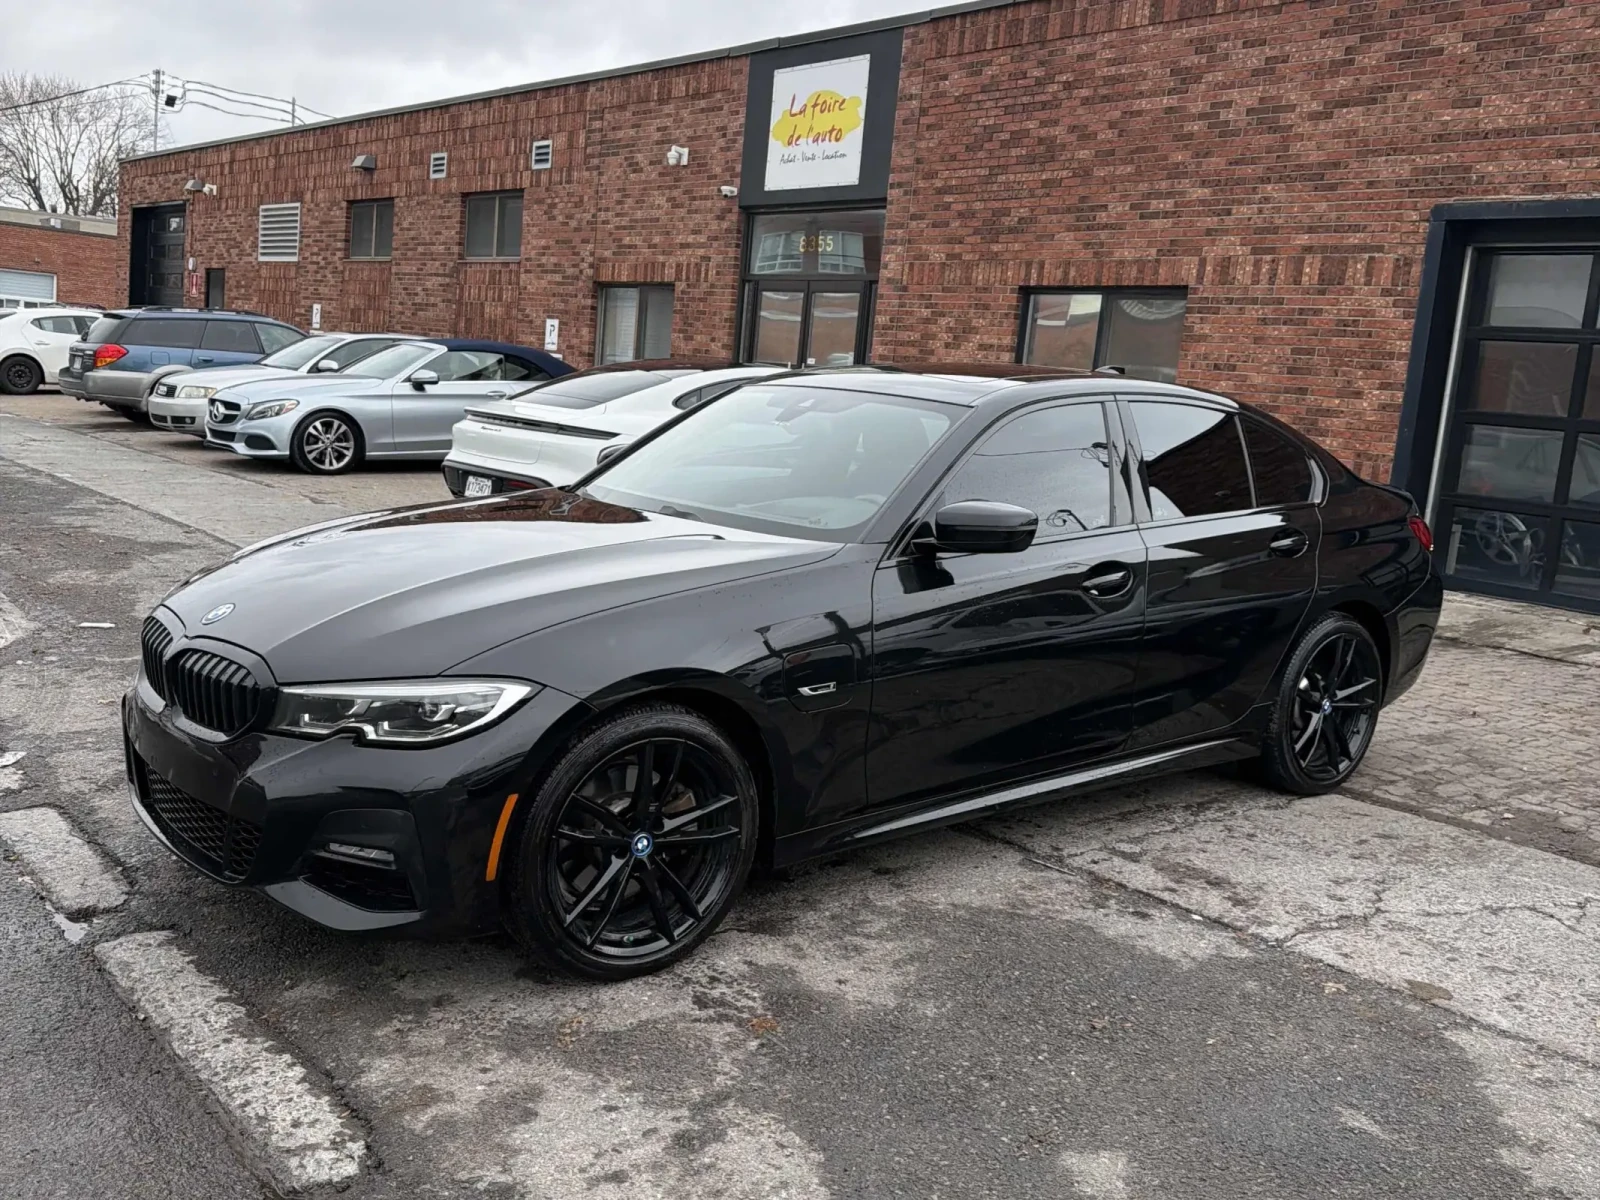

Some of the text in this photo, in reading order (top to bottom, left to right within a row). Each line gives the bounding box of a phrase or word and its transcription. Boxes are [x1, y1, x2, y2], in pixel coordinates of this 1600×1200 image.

[789, 93, 846, 120] La foire
[787, 124, 843, 147] de l'auto
[779, 153, 796, 165] Achat
[801, 151, 816, 162] Vente
[822, 149, 847, 160] Location
[799, 235, 833, 252] 8355
